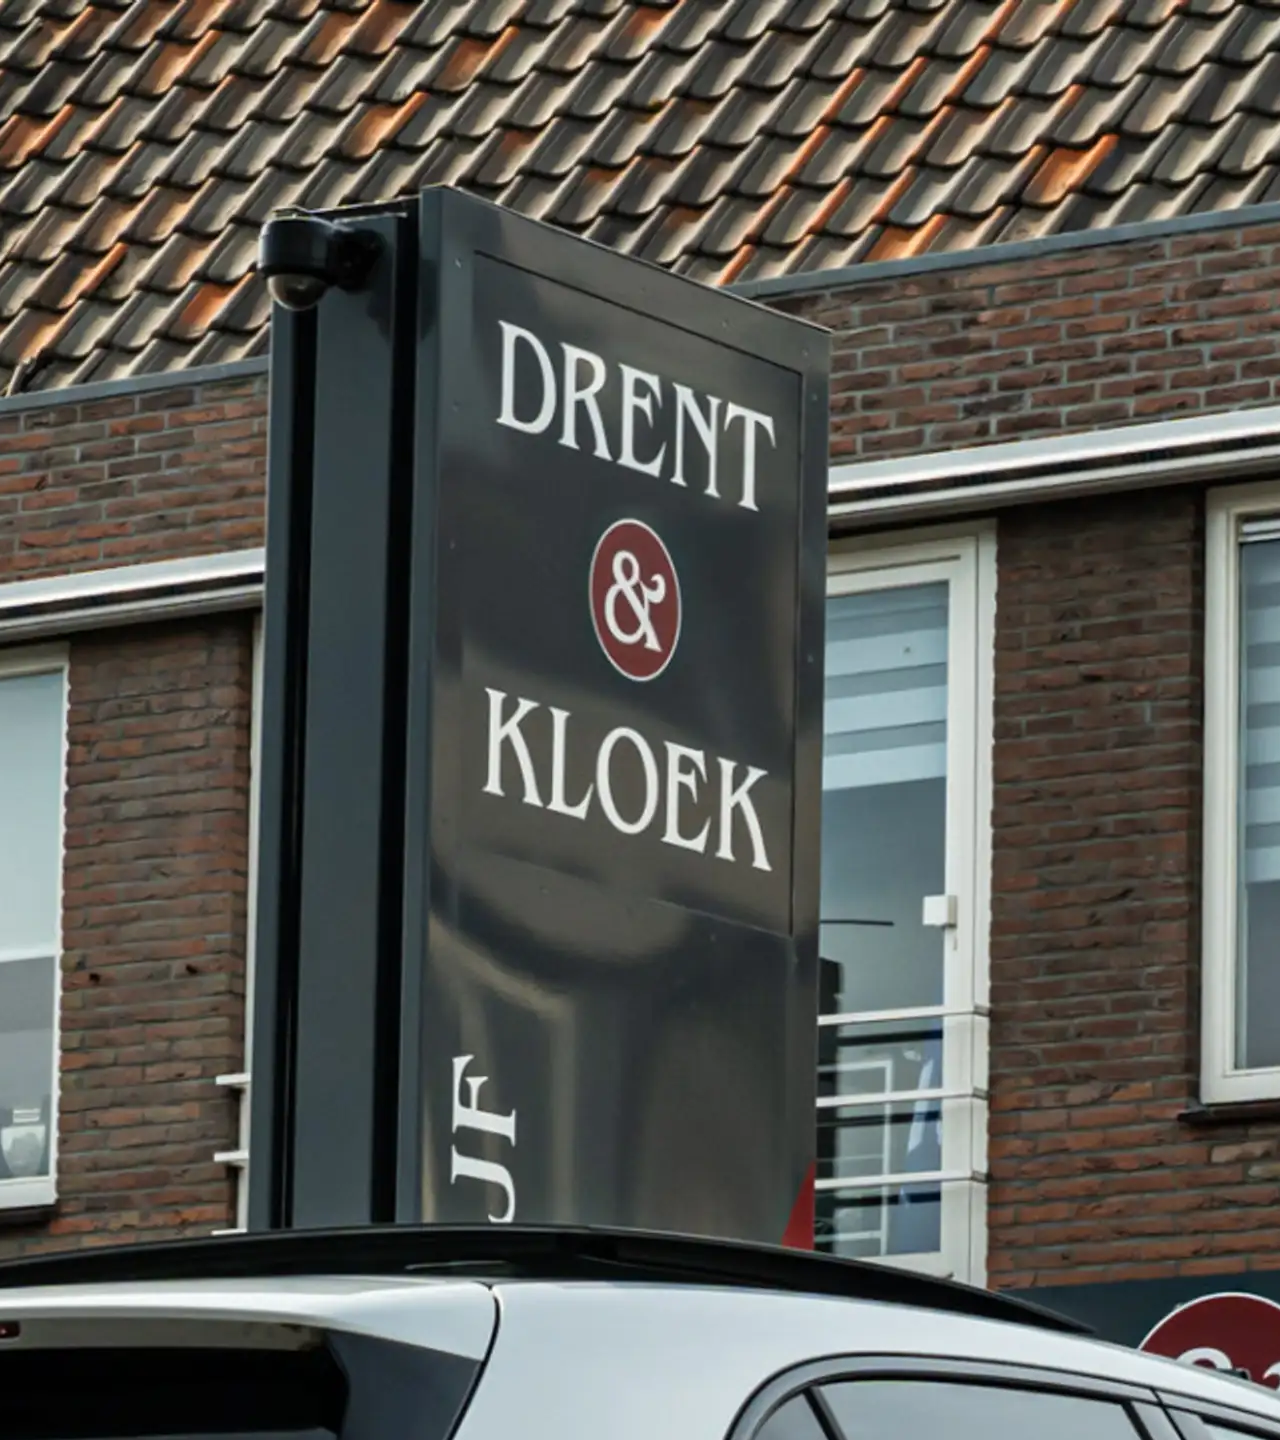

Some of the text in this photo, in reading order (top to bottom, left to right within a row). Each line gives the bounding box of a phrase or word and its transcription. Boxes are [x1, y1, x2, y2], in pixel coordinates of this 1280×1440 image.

[496, 320, 776, 512] DRENT
[604, 550, 667, 652] &
[482, 687, 772, 872] KLOEK
